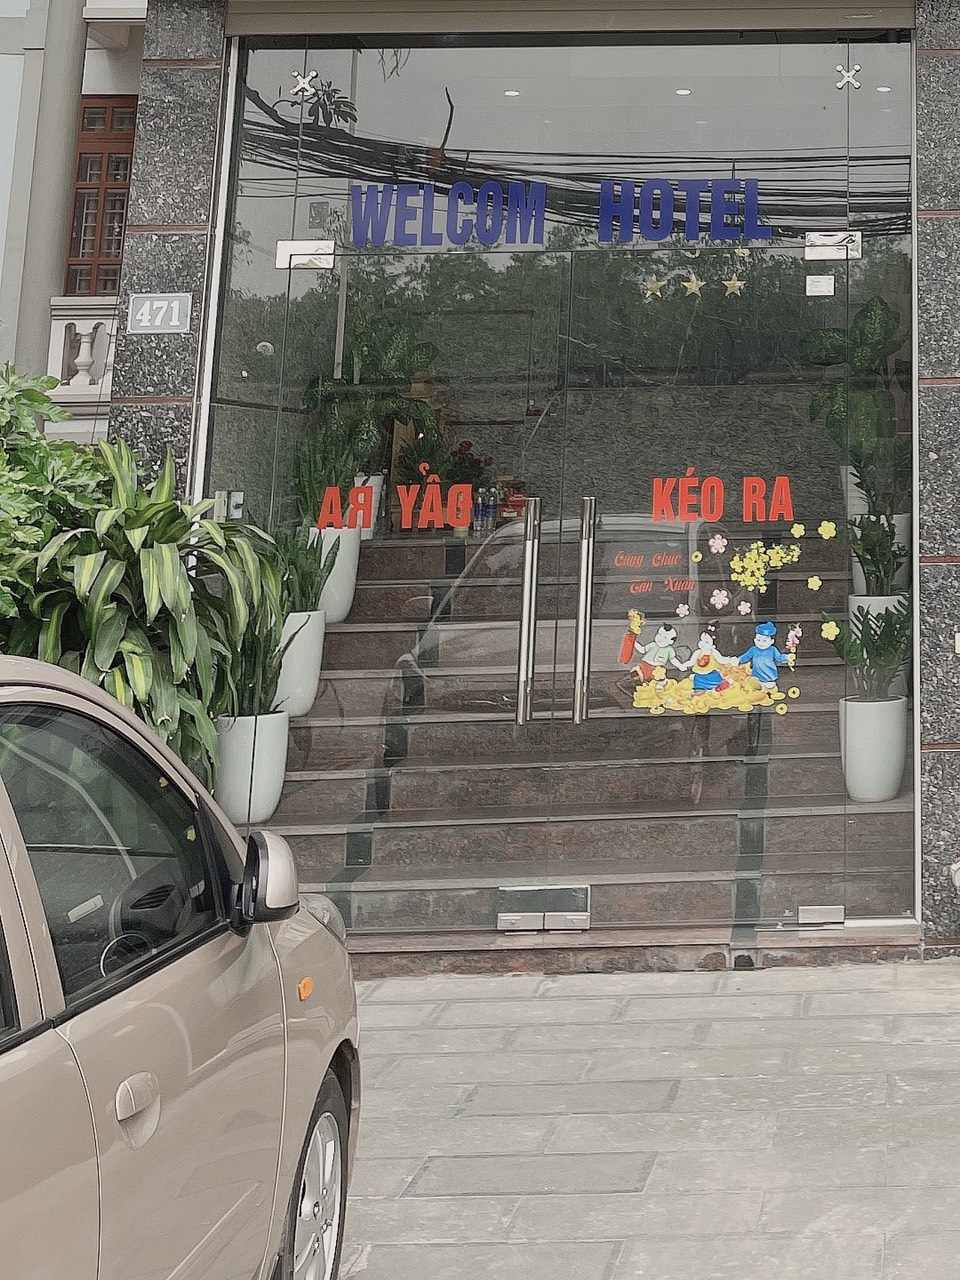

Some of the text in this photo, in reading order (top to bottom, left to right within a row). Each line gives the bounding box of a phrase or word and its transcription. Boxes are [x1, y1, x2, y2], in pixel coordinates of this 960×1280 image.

[350, 177, 773, 248] WELCOM HOTEL
[135, 300, 180, 327] 471
[652, 467, 794, 522] KÉO RA
